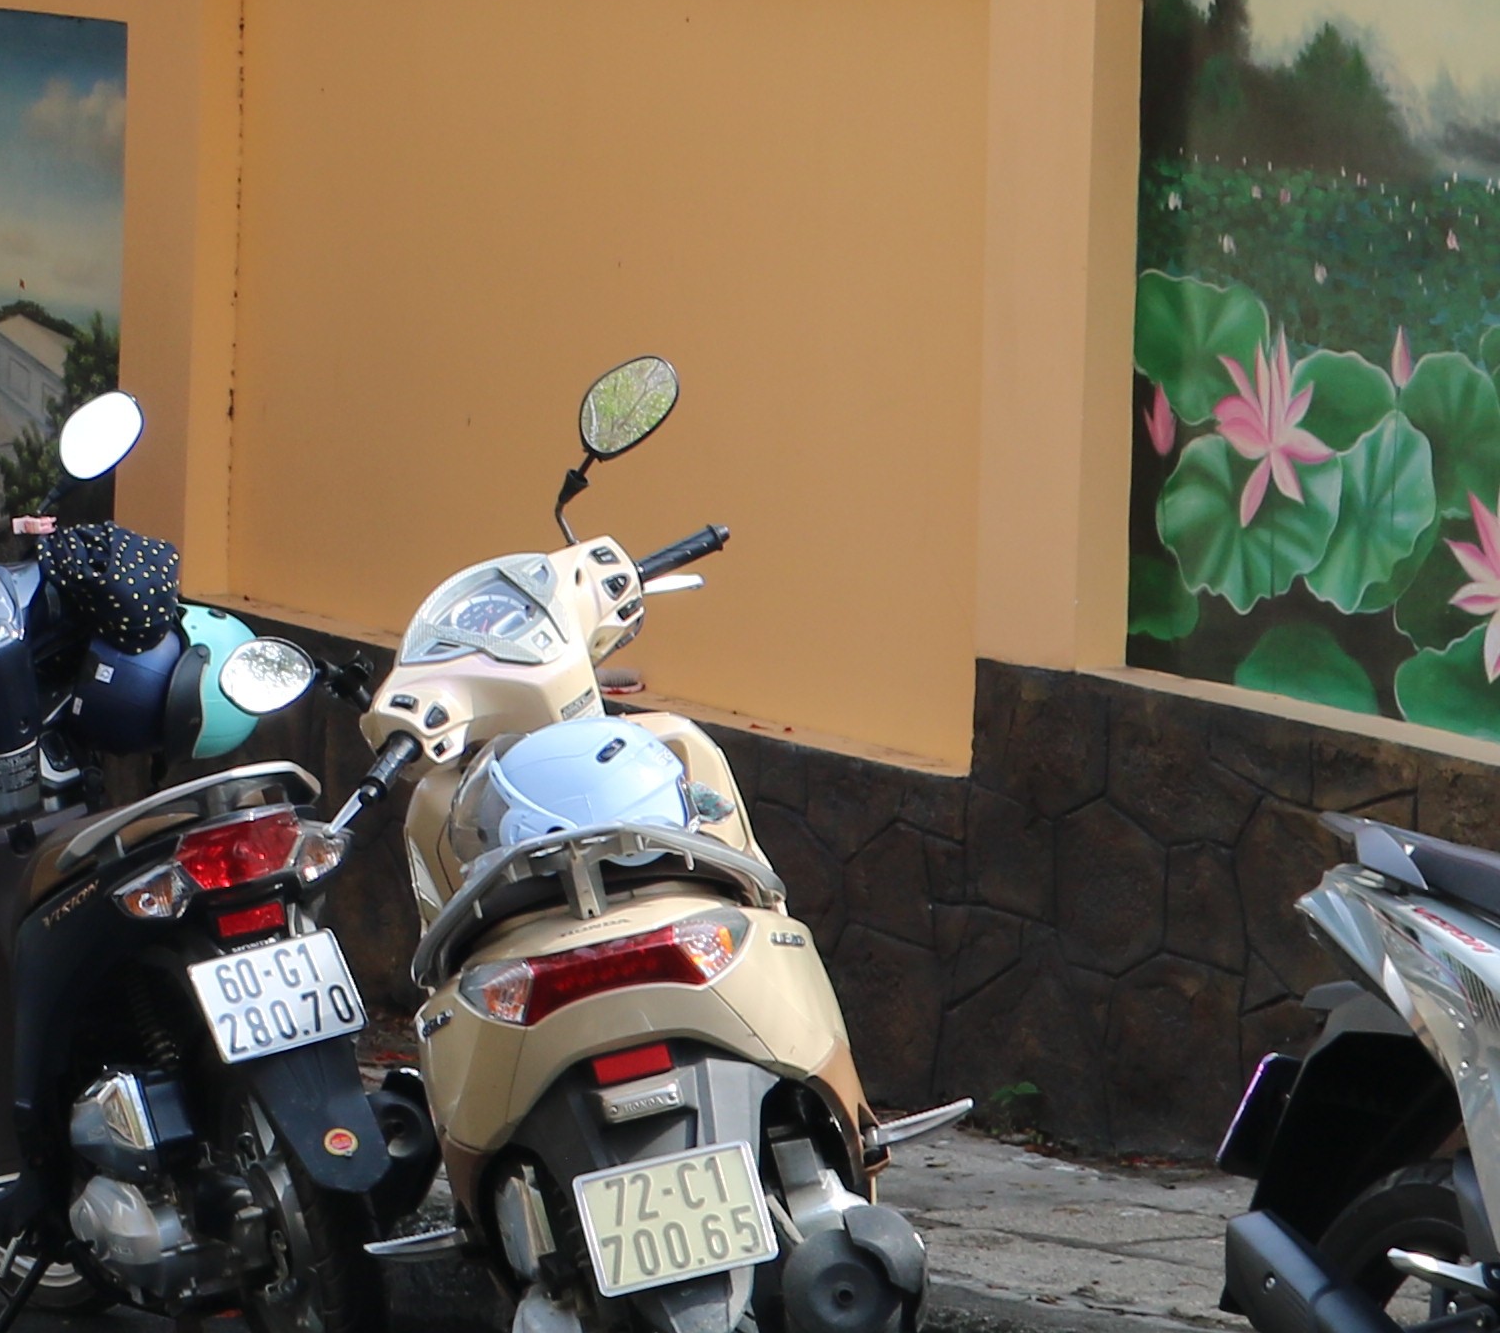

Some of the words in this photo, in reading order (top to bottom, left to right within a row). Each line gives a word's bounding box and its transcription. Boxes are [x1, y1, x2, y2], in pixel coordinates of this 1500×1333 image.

[215, 942, 323, 1005] 60-G1
[218, 983, 356, 1055] 280.70
[605, 1155, 730, 1227] 72-C1
[601, 1205, 761, 1285] 700.65
